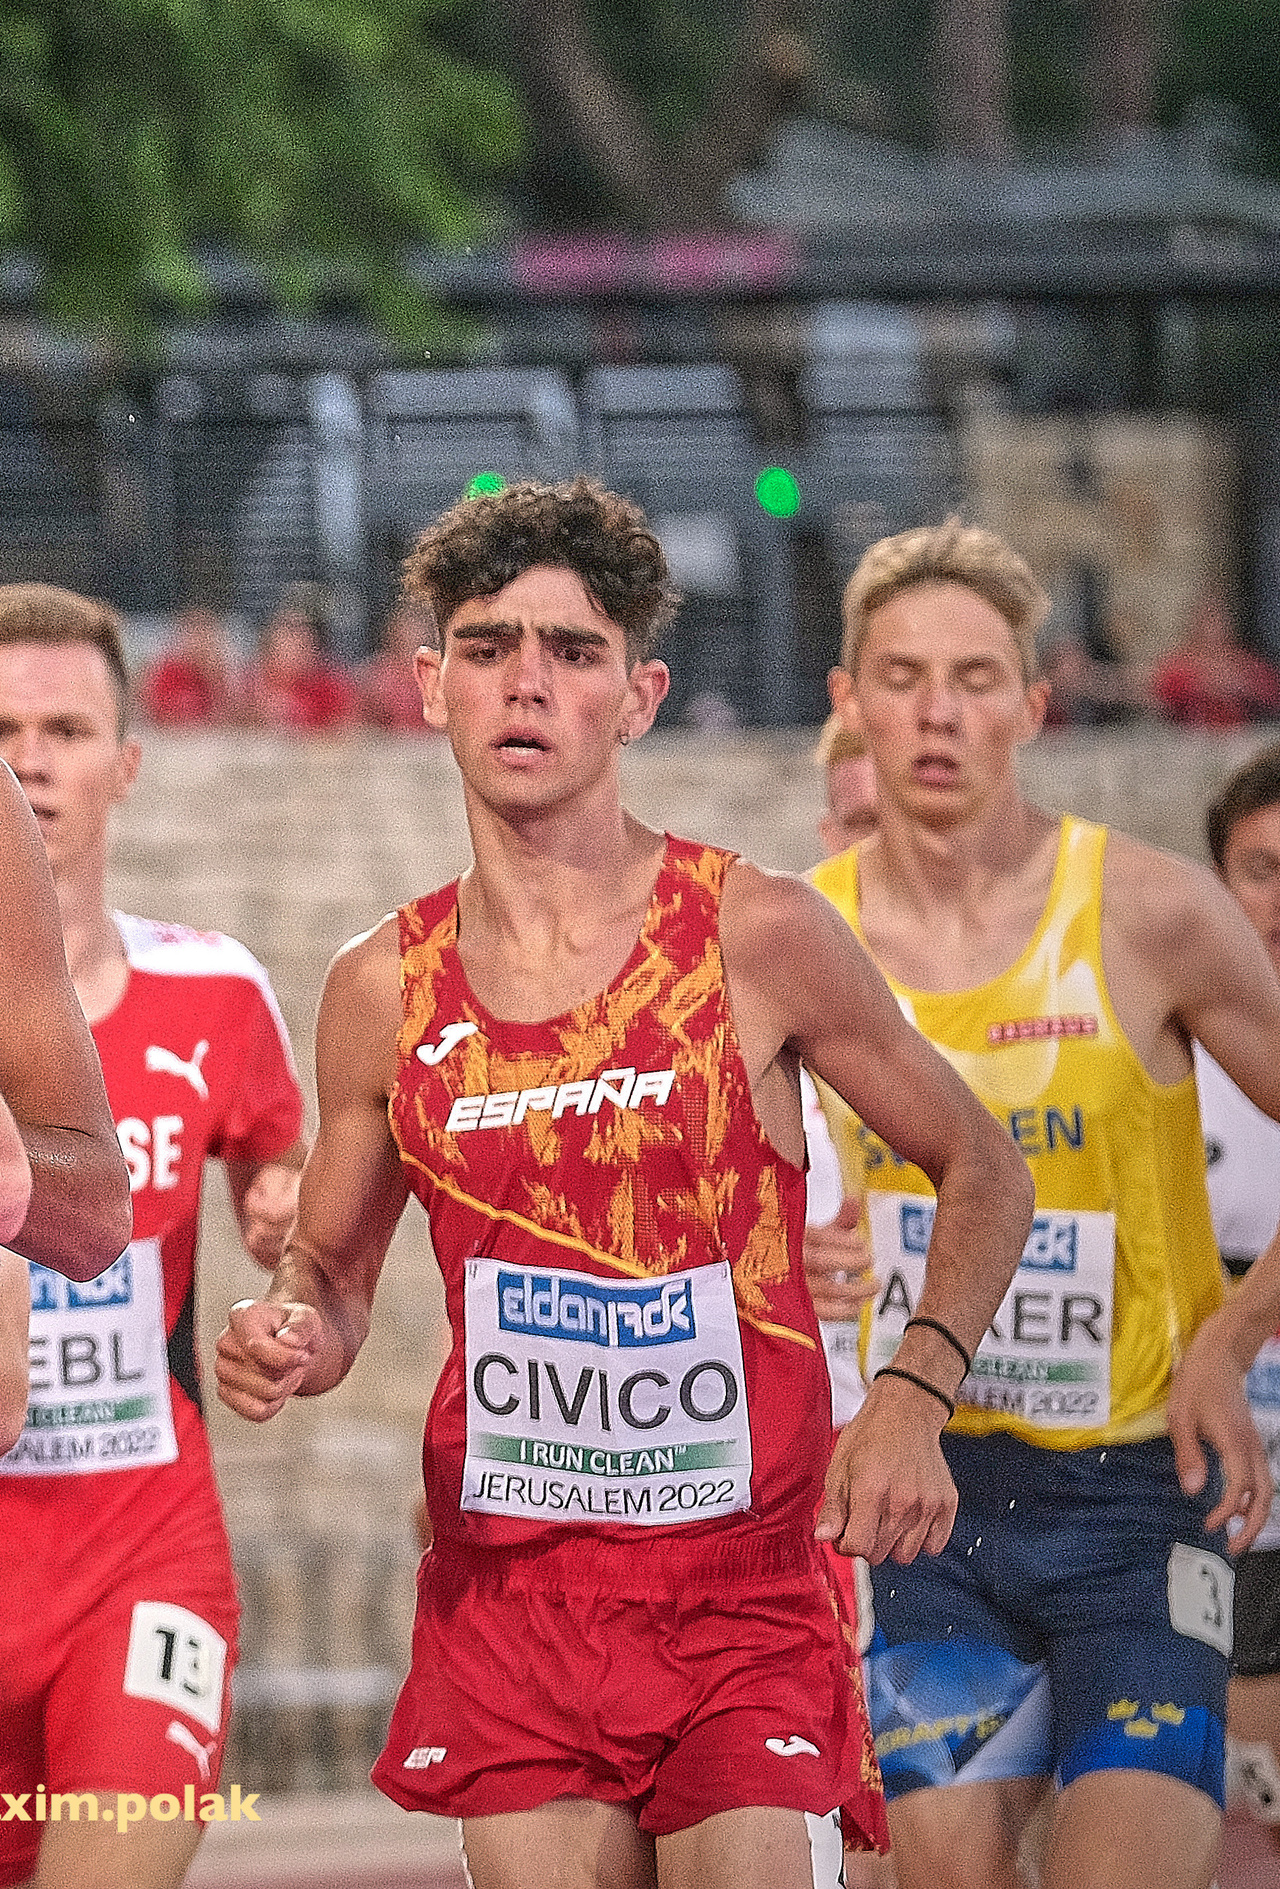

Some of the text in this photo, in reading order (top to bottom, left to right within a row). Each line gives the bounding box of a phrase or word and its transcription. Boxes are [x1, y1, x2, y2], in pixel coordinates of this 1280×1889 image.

[445, 1066, 676, 1133] ESPAÑA
[473, 1353, 739, 1433] CIVICO
[519, 1440, 527, 1461] I
[531, 1442, 583, 1470] RUN
[472, 1470, 736, 1514] JERUSALEM 2022
